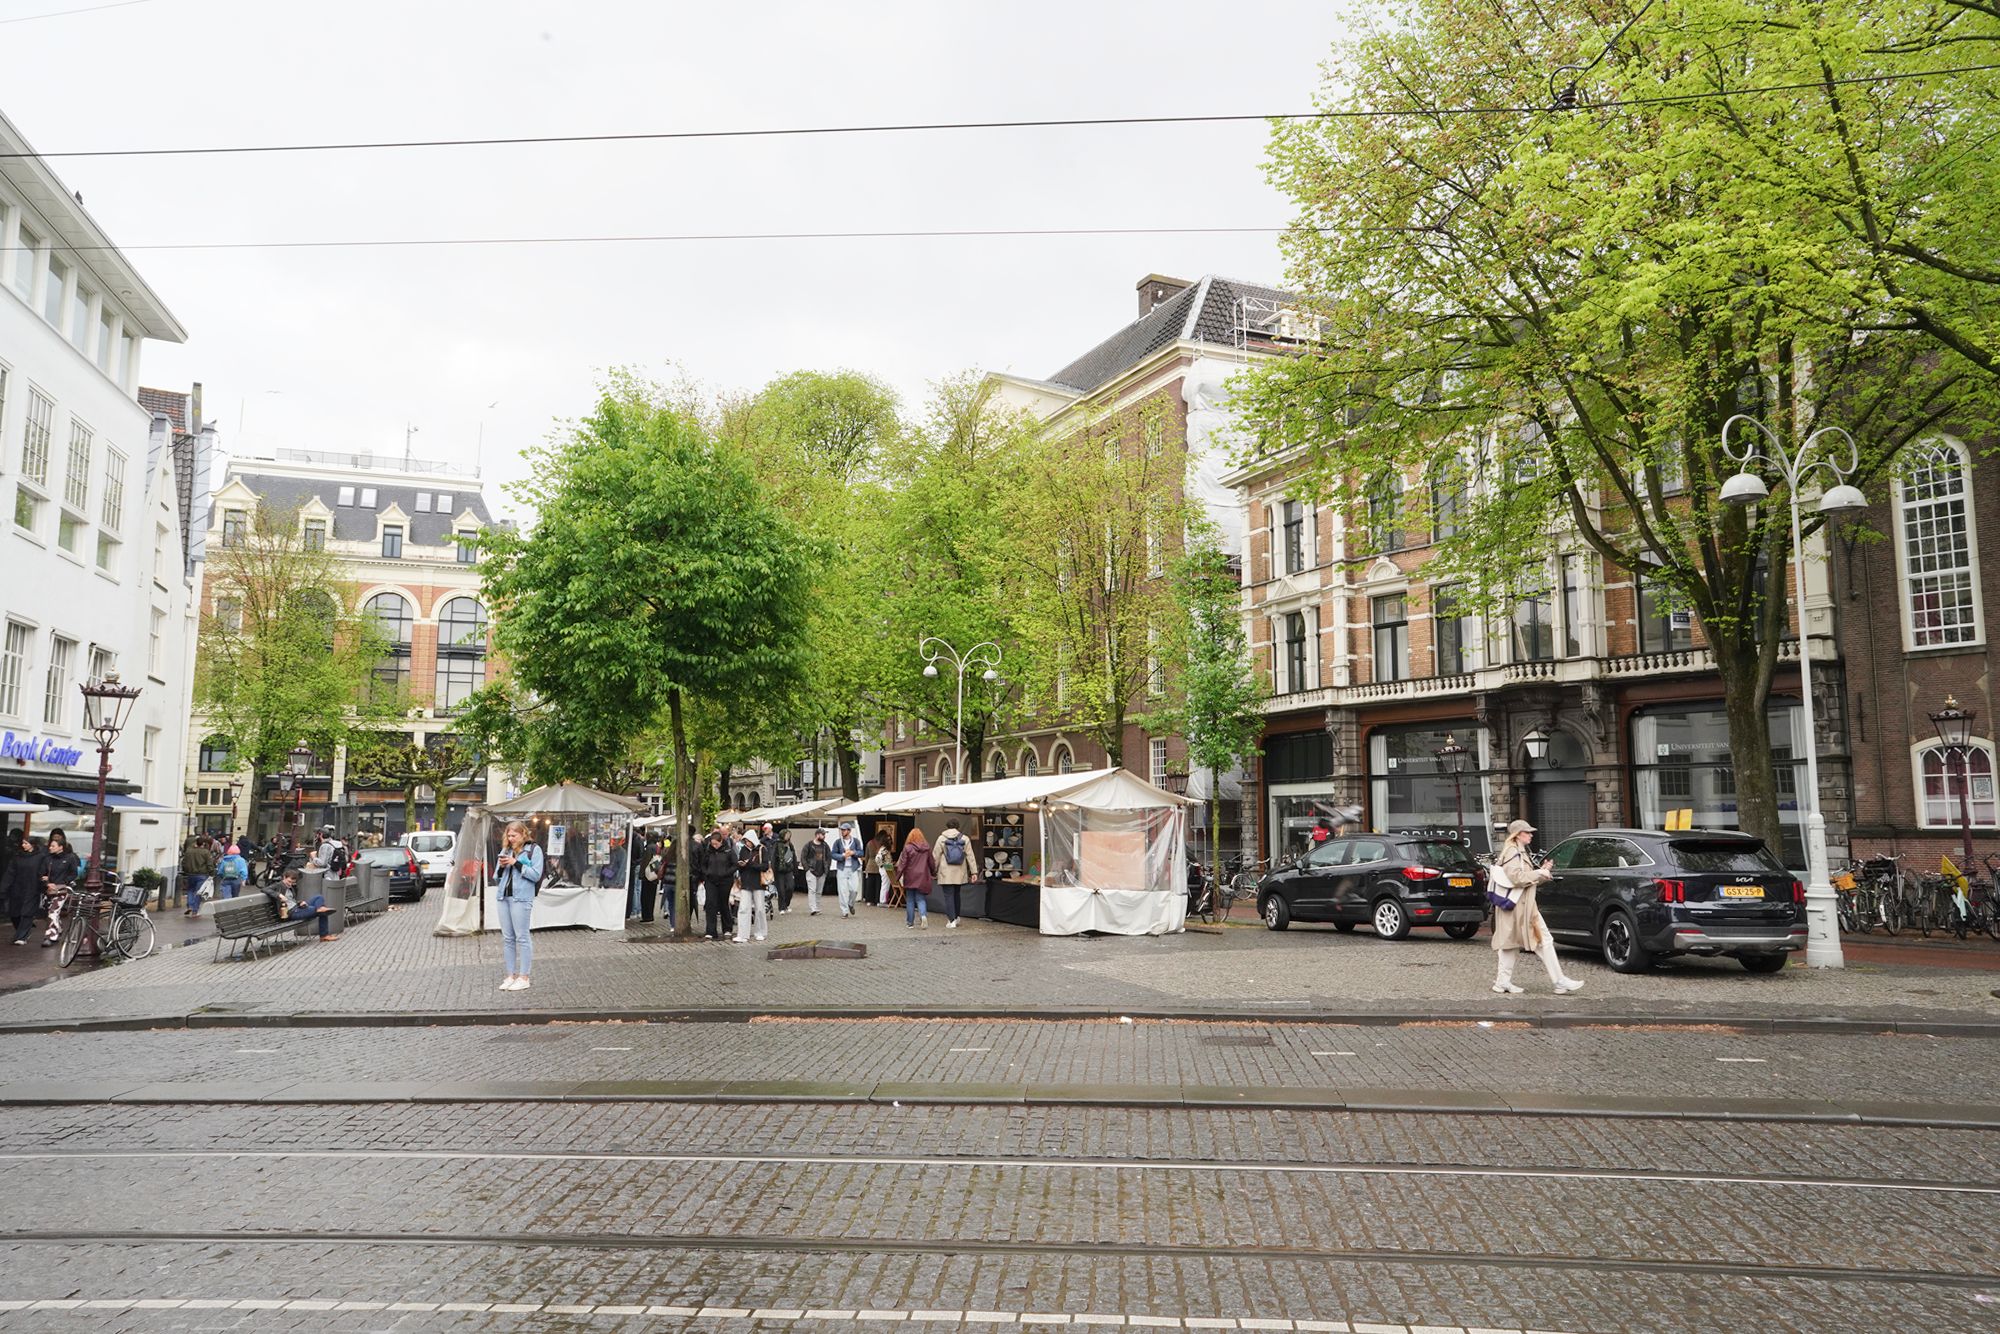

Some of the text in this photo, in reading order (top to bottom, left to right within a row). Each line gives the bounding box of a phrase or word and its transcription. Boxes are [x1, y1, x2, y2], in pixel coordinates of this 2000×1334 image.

[0, 731, 83, 766] Book Center
[1726, 888, 1762, 896] GSX-25-P
